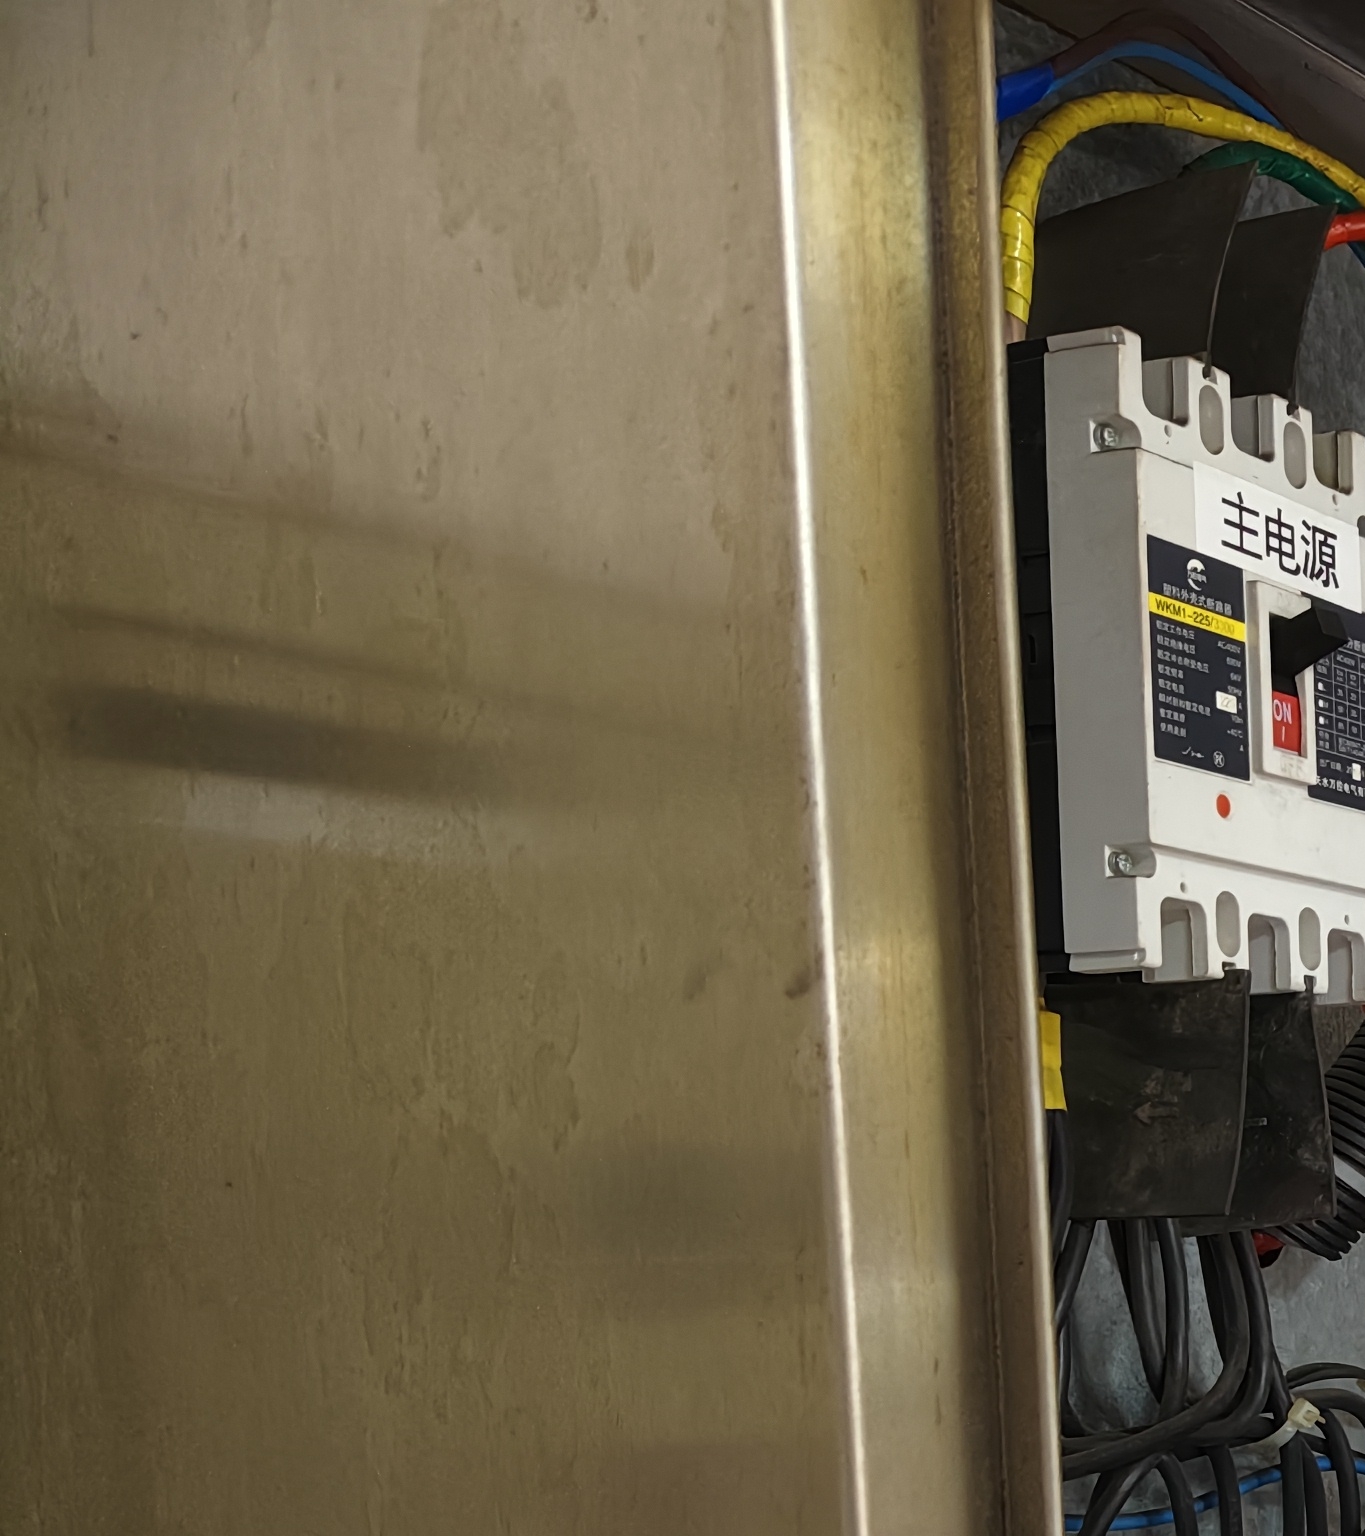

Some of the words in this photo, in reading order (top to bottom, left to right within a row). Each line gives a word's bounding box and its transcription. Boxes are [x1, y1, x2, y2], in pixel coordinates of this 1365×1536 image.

[1221, 491, 1339, 589] 主电源
[1273, 699, 1292, 725] ON
